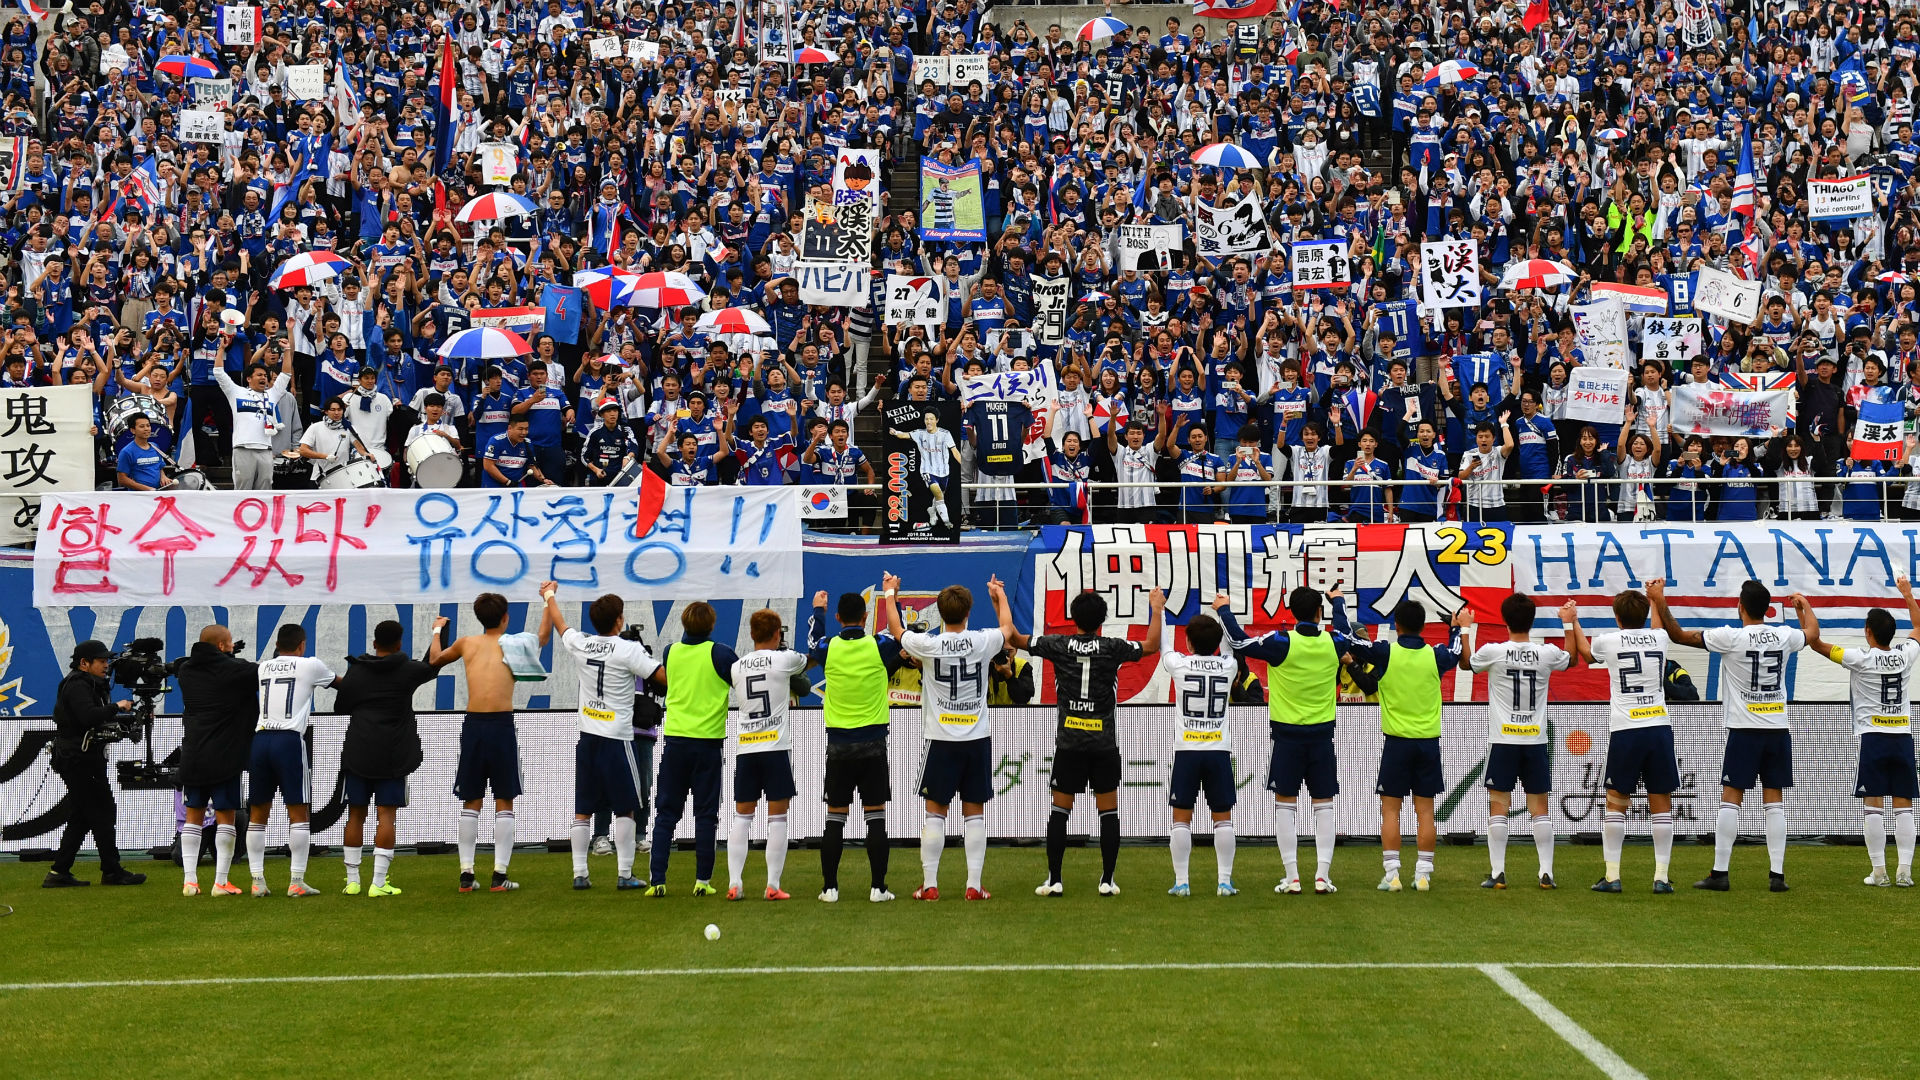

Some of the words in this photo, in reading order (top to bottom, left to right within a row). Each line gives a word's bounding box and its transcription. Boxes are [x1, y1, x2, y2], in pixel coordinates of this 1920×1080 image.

[239, 8, 253, 44] 松原健
[1238, 24, 1259, 40] 23
[769, 29, 781, 42] 6
[1684, 27, 1712, 44] TERU
[603, 38, 617, 53] 優
[763, 42, 788, 57] 貴宏
[923, 66, 939, 79] 23
[955, 64, 966, 79] 8
[193, 82, 231, 96] TERU
[1104, 80, 1127, 100] 13
[1351, 85, 1375, 111] 27
[493, 149, 504, 166] 9
[1812, 183, 1855, 195] THIAGO
[1121, 225, 1152, 239] WITH
[1217, 219, 1233, 236] 6
[815, 235, 831, 251] 11
[1126, 236, 1149, 250] BOSS
[1296, 248, 1324, 264] 扇原
[430, 262, 457, 272] NISSAN
[1297, 266, 1326, 282] 貴宏
[1443, 242, 1477, 303] 渓太
[801, 265, 869, 293] ハピバ
[894, 287, 911, 300] 27
[1016, 293, 1023, 303] 5
[1673, 280, 1690, 304] 8
[1733, 292, 1745, 308] 6
[554, 296, 566, 321] 4
[1048, 296, 1067, 310] Jr.
[890, 308, 938, 320] 松原健
[976, 311, 1002, 319] NISSAN
[1046, 310, 1064, 341] 9
[1388, 310, 1408, 336] 11
[1647, 320, 1700, 338] 鉄壁の
[1655, 341, 1690, 359] 畠中
[1471, 357, 1490, 383] 11
[966, 363, 1048, 402] 二俣川
[1574, 390, 1620, 406] タイトルを
[886, 404, 916, 419] KEITA
[986, 402, 1008, 412] MUGEN
[1277, 402, 1307, 411] NISSAN
[485, 412, 510, 420] NISSAN
[893, 410, 921, 425] ENDO
[987, 414, 1009, 441] 11
[1862, 423, 1898, 442] 渓太
[908, 448, 916, 472] GOAL
[1883, 448, 1898, 460] 11
[495, 458, 526, 467] NISSAN
[888, 452, 913, 522] 22,000
[130, 496, 215, 595] 수
[720, 496, 776, 577] !!
[1435, 527, 1507, 566] 23
[1053, 527, 1468, 619] 仲川輝人
[941, 637, 973, 653] MUGEN
[1067, 638, 1100, 653] MUGEN
[1621, 634, 1657, 645] MUGEN
[1749, 632, 1780, 645] MUGEN
[739, 656, 772, 670] MUGEN
[1505, 649, 1539, 662] MUGEN
[1875, 654, 1905, 668] MUGEN
[264, 661, 297, 673] MUGEN
[1617, 651, 1664, 693] 27
[1746, 650, 1783, 691] 13
[586, 658, 606, 700] 7
[934, 657, 982, 701] 44
[1076, 656, 1091, 700] 1
[745, 673, 771, 720] 5
[889, 691, 921, 702] Canon
[1182, 675, 1229, 719] 26
[1506, 669, 1537, 711] 11
[1881, 673, 1903, 705] 8
[260, 677, 297, 720] 17
